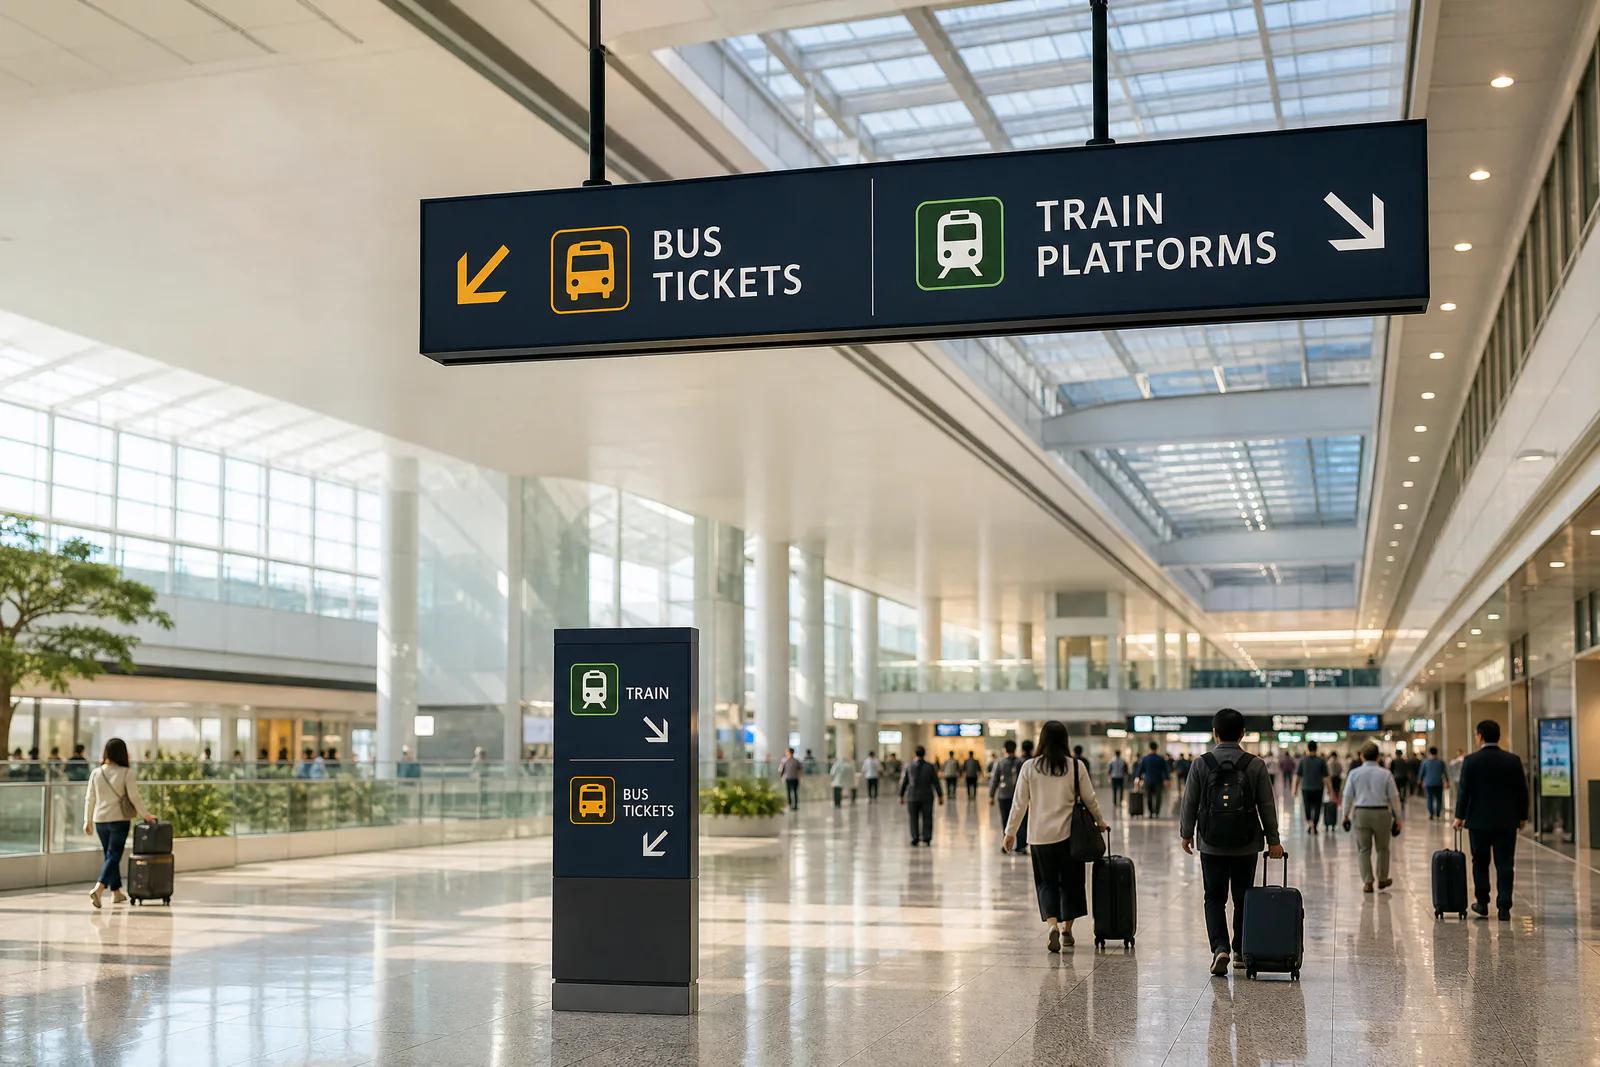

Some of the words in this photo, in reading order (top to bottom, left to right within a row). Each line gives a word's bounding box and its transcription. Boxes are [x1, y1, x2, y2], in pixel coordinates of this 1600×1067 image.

[1036, 192, 1163, 230] TRAIN
[653, 225, 722, 261] BUS
[1038, 231, 1277, 278] PLATFORMS
[653, 263, 802, 302] TICKETS
[626, 687, 669, 700] TRAIN
[623, 788, 649, 801] BUS
[623, 804, 675, 817] TICKETS
